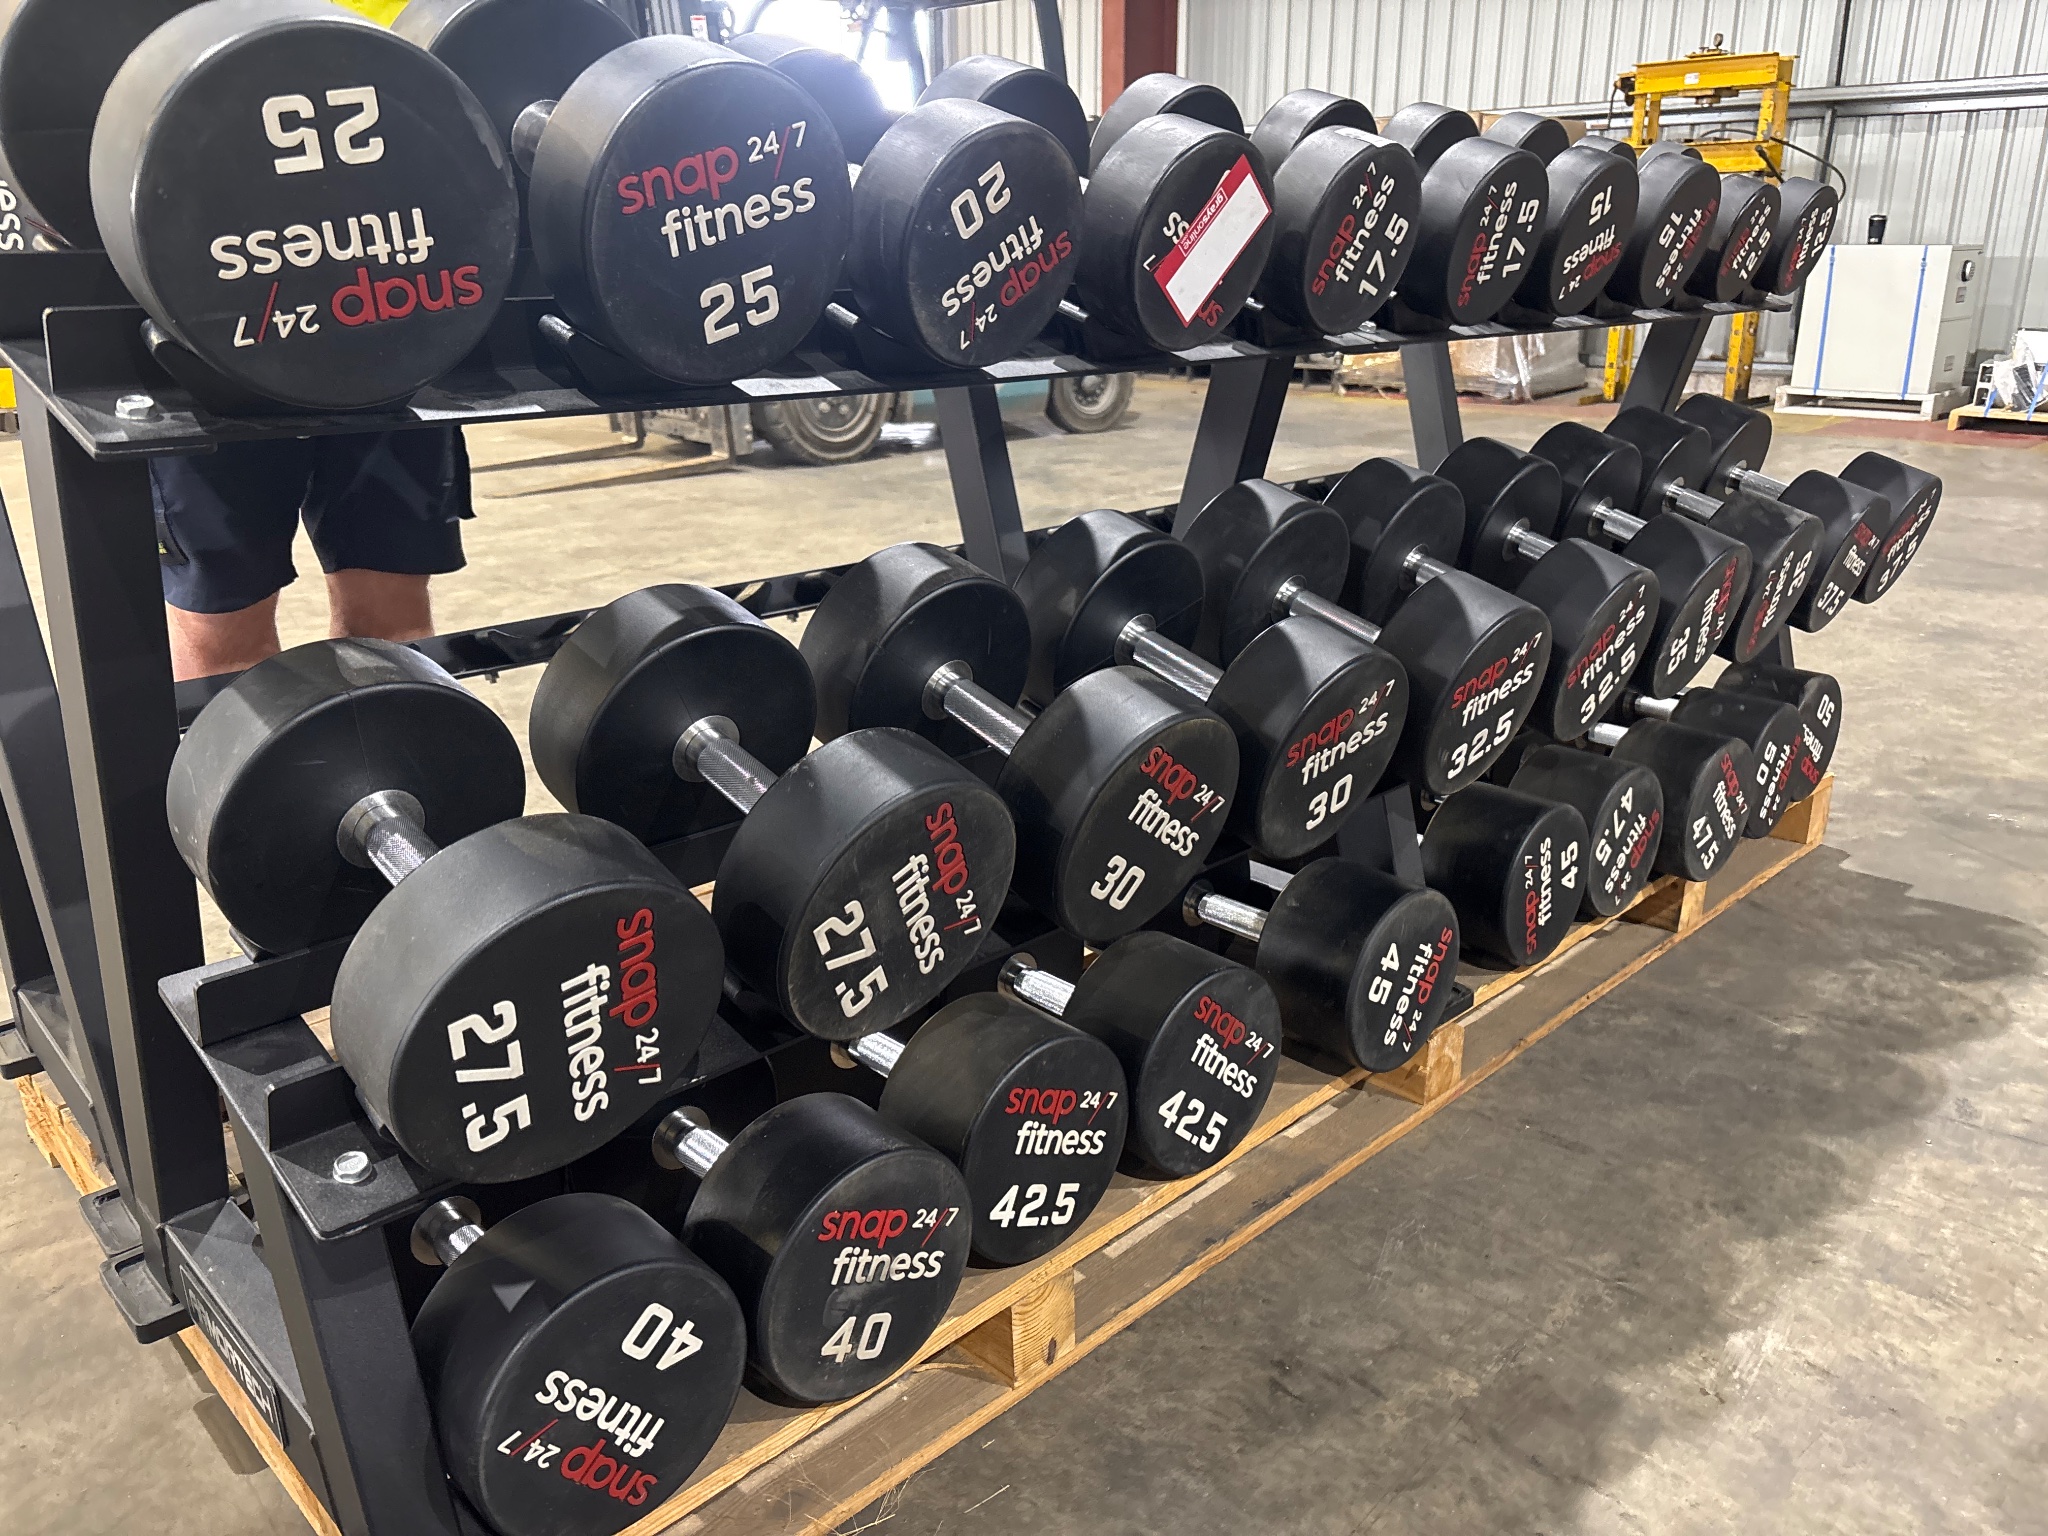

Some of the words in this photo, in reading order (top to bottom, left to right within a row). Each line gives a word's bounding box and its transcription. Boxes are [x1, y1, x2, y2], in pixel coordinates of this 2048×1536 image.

[261, 85, 385, 175] 25
[617, 144, 739, 216] snap
[747, 120, 807, 180] 24/7
[951, 161, 1011, 239] 20
[661, 176, 817, 259] fitness
[1183, 192, 1224, 250] graysonline
[1311, 214, 1355, 296] snap
[1352, 162, 1376, 209] 24/7
[1335, 175, 1394, 282] fitness
[1477, 182, 1517, 284] fitness
[1502, 199, 1539, 278] 17.5
[1589, 185, 1612, 226] 15
[1658, 212, 1683, 248] 15
[210, 208, 434, 280] fitness
[942, 216, 1043, 317] fitness
[1000, 230, 1072, 307] snap
[1358, 213, 1408, 296] 17.5
[1457, 233, 1488, 307] snap
[1480, 185, 1498, 226] 24/7
[1563, 224, 1615, 274] fitness
[1583, 241, 1622, 280] snap
[233, 282, 320, 348] 24/7
[331, 265, 484, 327] snap
[699, 263, 780, 345] 25
[960, 301, 997, 350] 24/7
[1452, 657, 1508, 709] snap
[1511, 632, 1543, 668] 24/7
[1566, 624, 1615, 689] snap
[1619, 584, 1645, 622] 24/7
[1581, 605, 1645, 689] fitness
[1461, 662, 1534, 727] fitness
[1581, 643, 1637, 724] 32.5
[1286, 708, 1355, 768] snap
[1357, 679, 1395, 720] 24/7
[1302, 712, 1388, 786] fitness
[1447, 709, 1515, 779] 32.5
[1140, 746, 1197, 805] snap
[1191, 784, 1225, 823] 24/7
[1756, 741, 1777, 785] 50
[1127, 788, 1200, 857] fitness
[1305, 773, 1353, 831] 30
[1595, 787, 1633, 867] 47.5
[925, 802, 968, 894] snap
[1525, 856, 1539, 889] 24/7
[1561, 841, 1578, 889] 45
[1605, 814, 1647, 894] fitness
[1630, 809, 1660, 869] snap
[1693, 816, 1719, 870] 47.5
[892, 854, 945, 975] fitness
[944, 889, 982, 935] 24/7
[1090, 854, 1145, 910] 30
[1538, 837, 1552, 926] fitness
[1526, 890, 1540, 955] snap
[609, 908, 659, 1028] snap
[813, 900, 889, 1018] 27.5
[1368, 942, 1400, 1005] 45
[1418, 927, 1453, 1004] snap
[1384, 943, 1433, 1046] fitness
[561, 963, 610, 1121] fitness
[614, 1027, 662, 1084] 24/7
[1194, 995, 1246, 1049] snap
[1245, 1031, 1275, 1066] 24/7
[1402, 1010, 1422, 1053] 24/7
[447, 1000, 531, 1153] 27.5
[1190, 1033, 1258, 1099] fitness
[1005, 1087, 1077, 1125] snap
[1079, 1091, 1118, 1126] 24/7
[1014, 1120, 1106, 1156] fitness
[1158, 1089, 1228, 1154] 42.5
[818, 1208, 908, 1249] snap
[912, 1207, 960, 1248] 24/7
[989, 1182, 1080, 1228] 42.5
[830, 1246, 945, 1286] fitness
[621, 1302, 704, 1371] 40
[820, 1312, 892, 1363] 40
[497, 1418, 561, 1469] 24/7
[534, 1370, 665, 1458] fitness
[560, 1438, 658, 1506] snap
